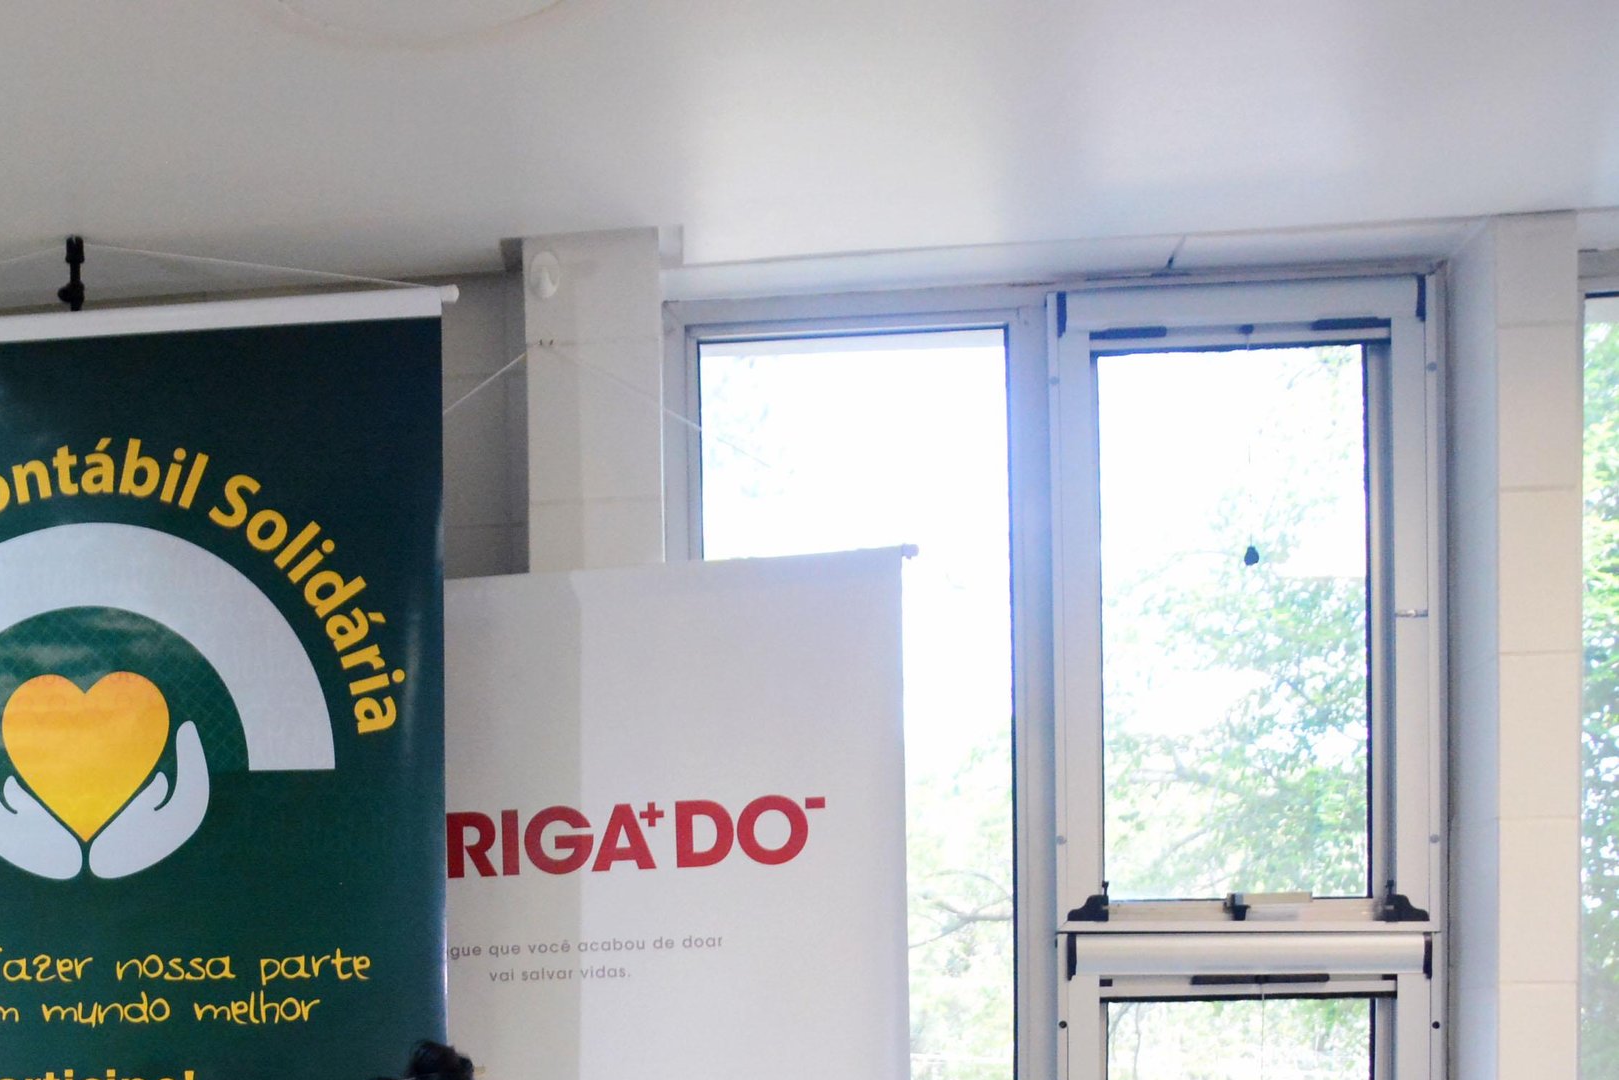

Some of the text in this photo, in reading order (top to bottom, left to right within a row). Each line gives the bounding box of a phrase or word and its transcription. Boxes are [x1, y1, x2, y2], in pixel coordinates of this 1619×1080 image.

[209, 474, 406, 734] Solidária
[447, 935, 723, 960] gue que você acabou de doar
[115, 954, 237, 982] nossa
[260, 947, 372, 985] parte
[489, 965, 631, 982] vai salvar vidas.
[42, 991, 171, 1026] mundo
[193, 991, 320, 1026] melhor
